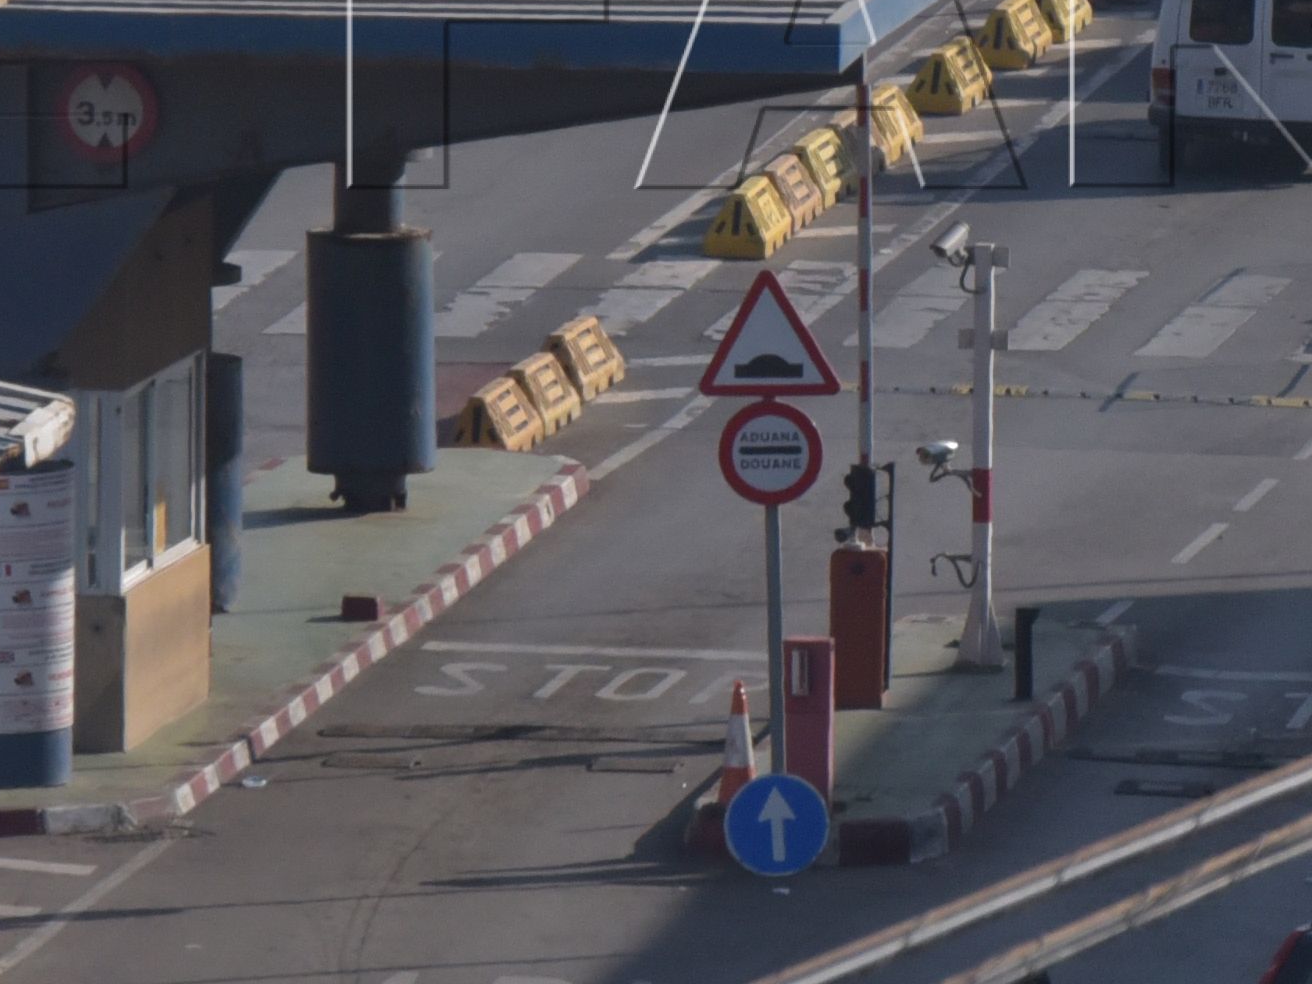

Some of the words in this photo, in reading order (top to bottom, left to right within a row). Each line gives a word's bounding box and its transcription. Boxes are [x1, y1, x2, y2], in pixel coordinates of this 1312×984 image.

[739, 431, 800, 442] ADUANA
[739, 458, 802, 470] DOUANE
[413, 661, 769, 704] STOP
